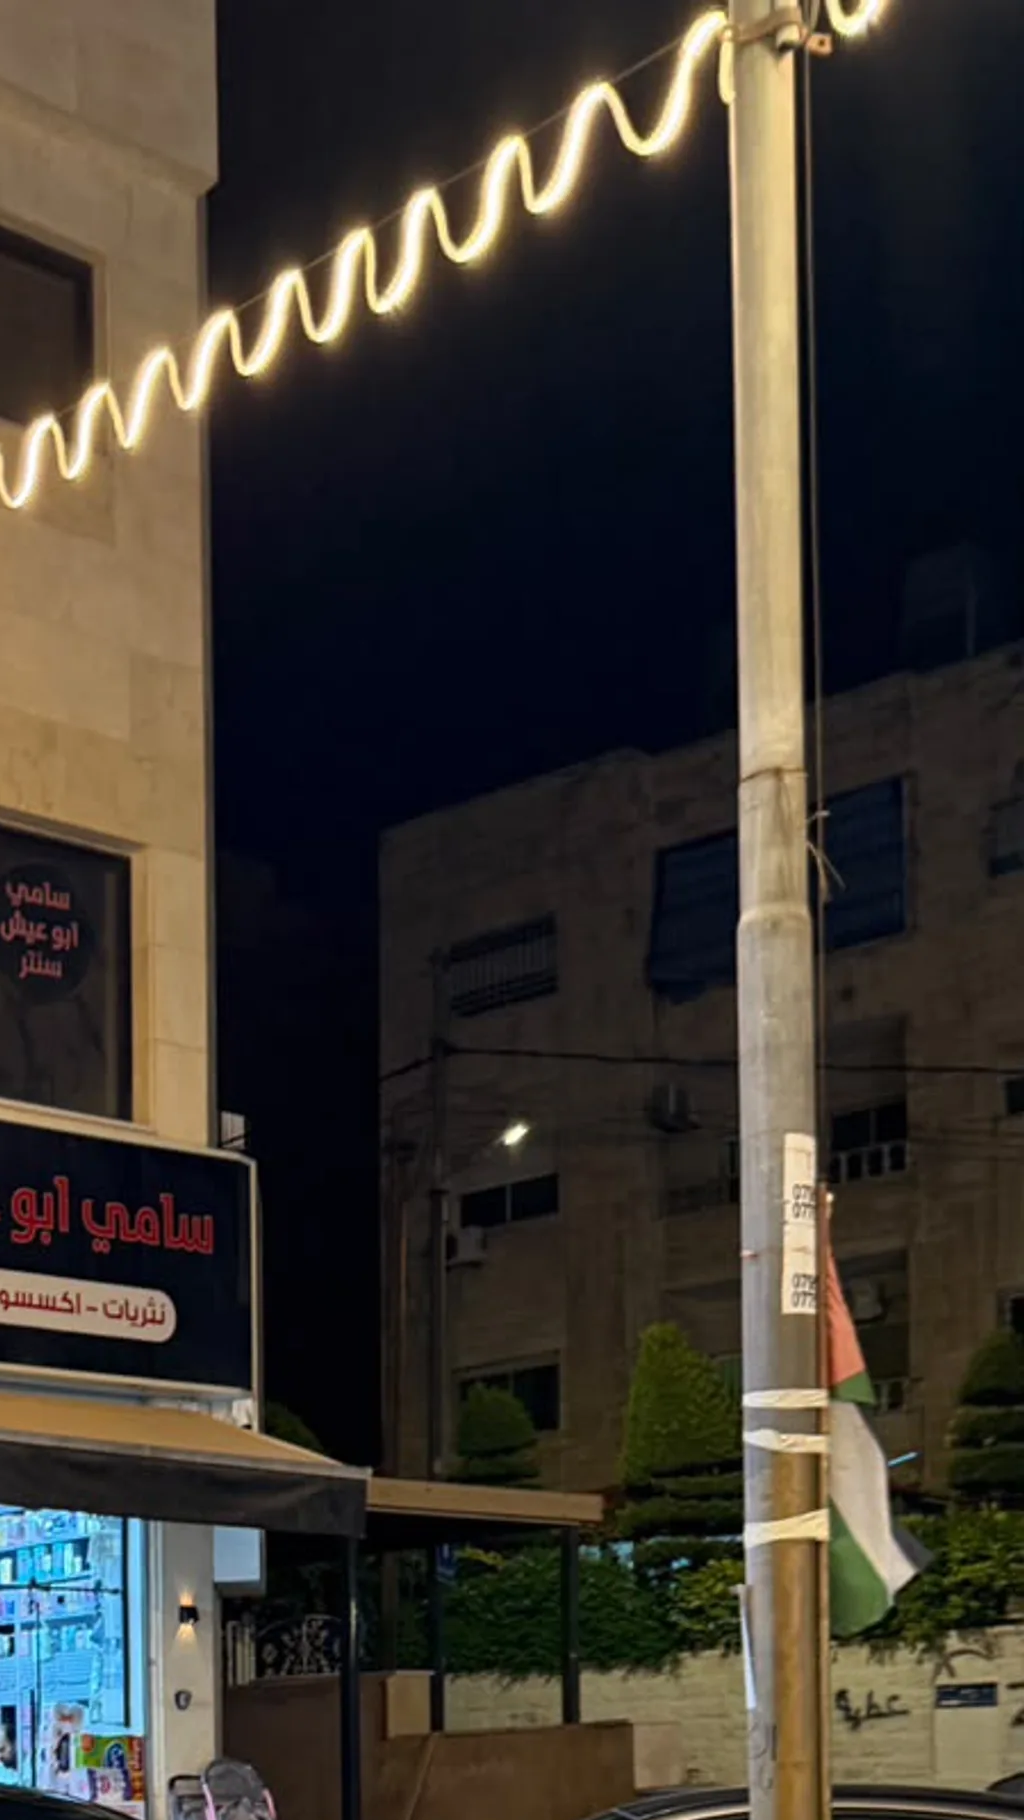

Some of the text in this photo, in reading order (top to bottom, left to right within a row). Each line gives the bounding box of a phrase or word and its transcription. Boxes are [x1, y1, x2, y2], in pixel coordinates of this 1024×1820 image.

[4, 882, 70, 911] سامي
[0, 909, 79, 951] ابو عيش
[19, 950, 63, 980] سنتر
[10, 1175, 70, 1245] ابو
[81, 1191, 213, 1254] سامي
[102, 1294, 167, 1329] نثريات
